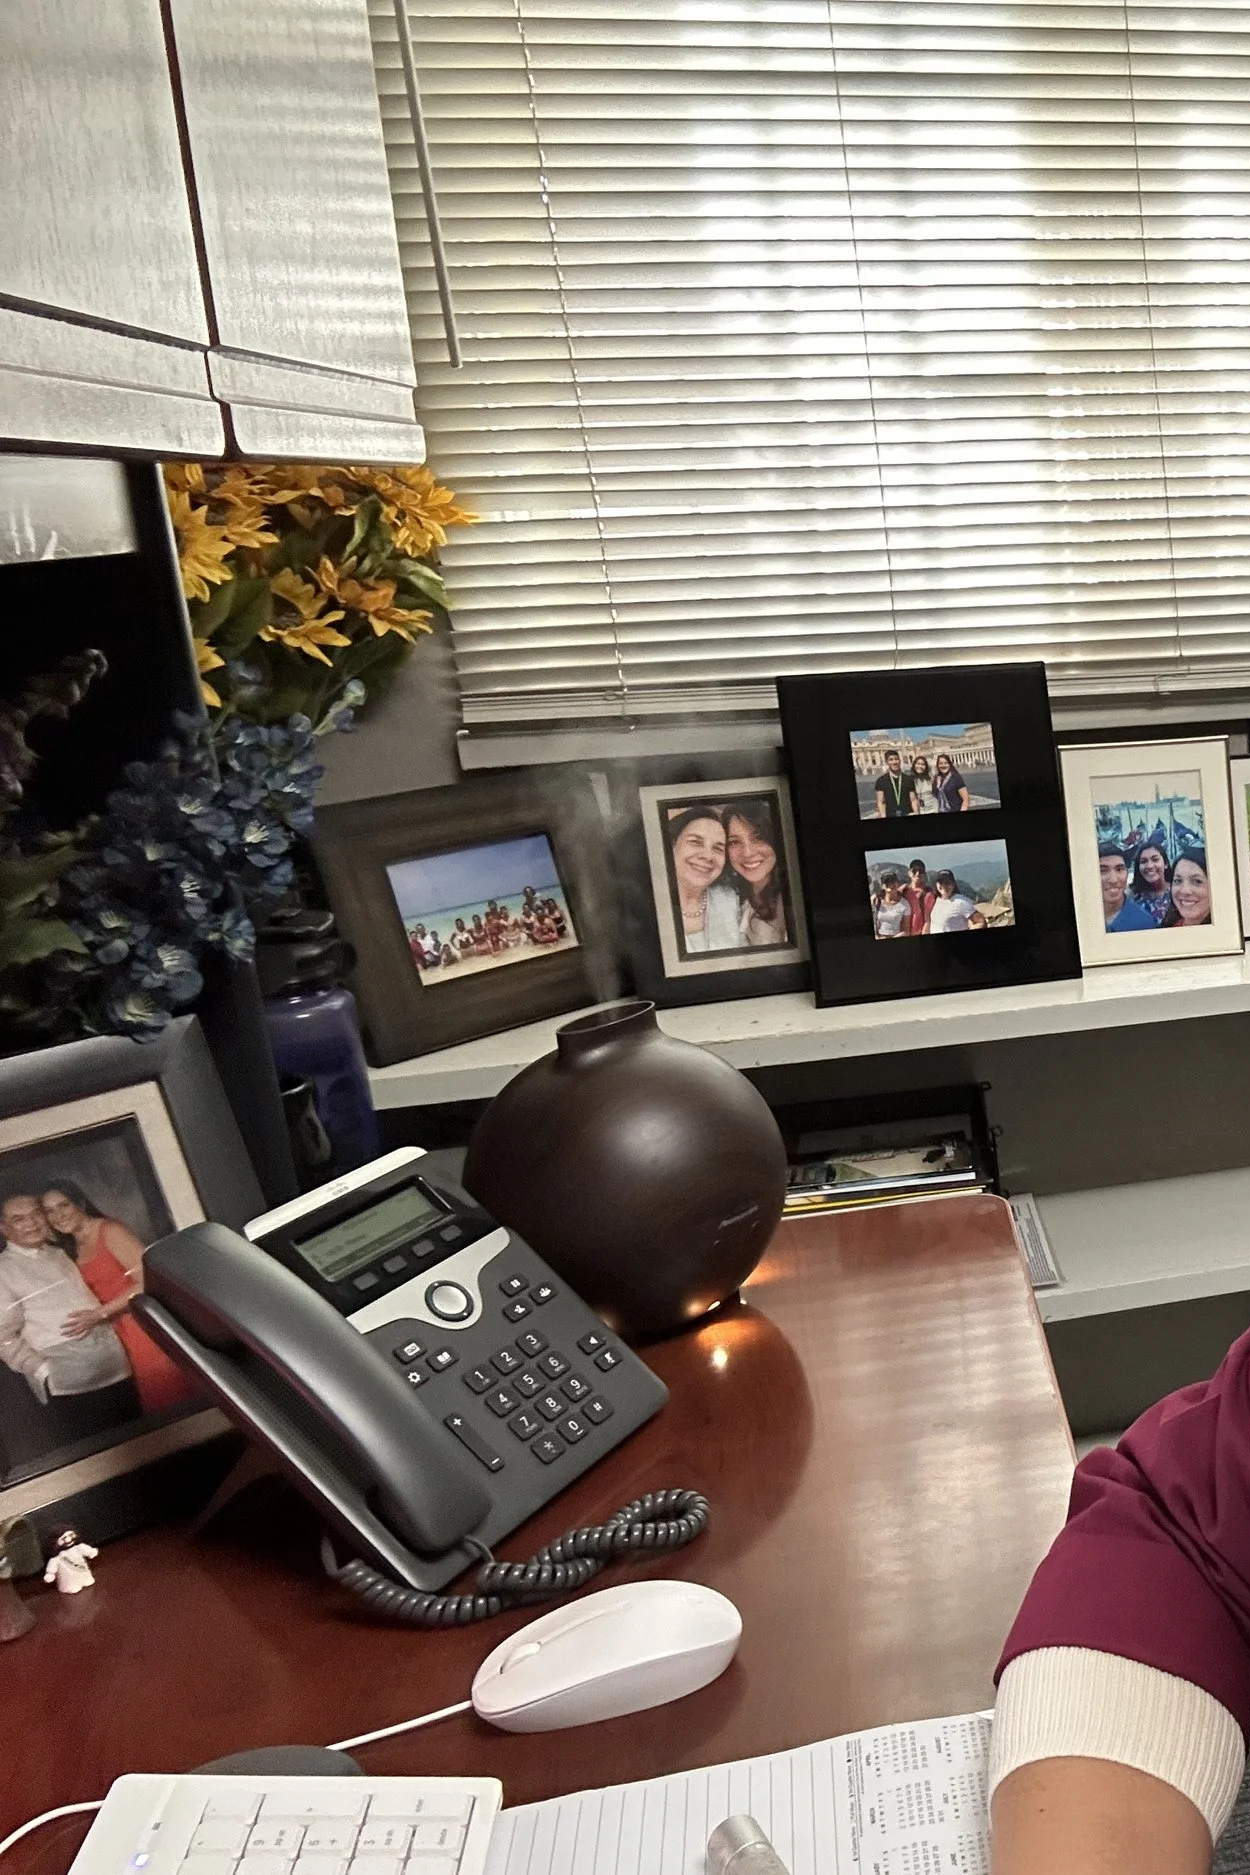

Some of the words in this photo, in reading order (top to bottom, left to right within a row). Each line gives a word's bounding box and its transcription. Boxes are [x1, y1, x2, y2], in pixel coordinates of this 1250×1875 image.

[500, 1351, 513, 1363] 2
[526, 1334, 538, 1345] 3
[522, 1374, 534, 1385] 5
[548, 1356, 559, 1367] 6
[545, 1397, 557, 1408] 8
[570, 1379, 581, 1390] 9
